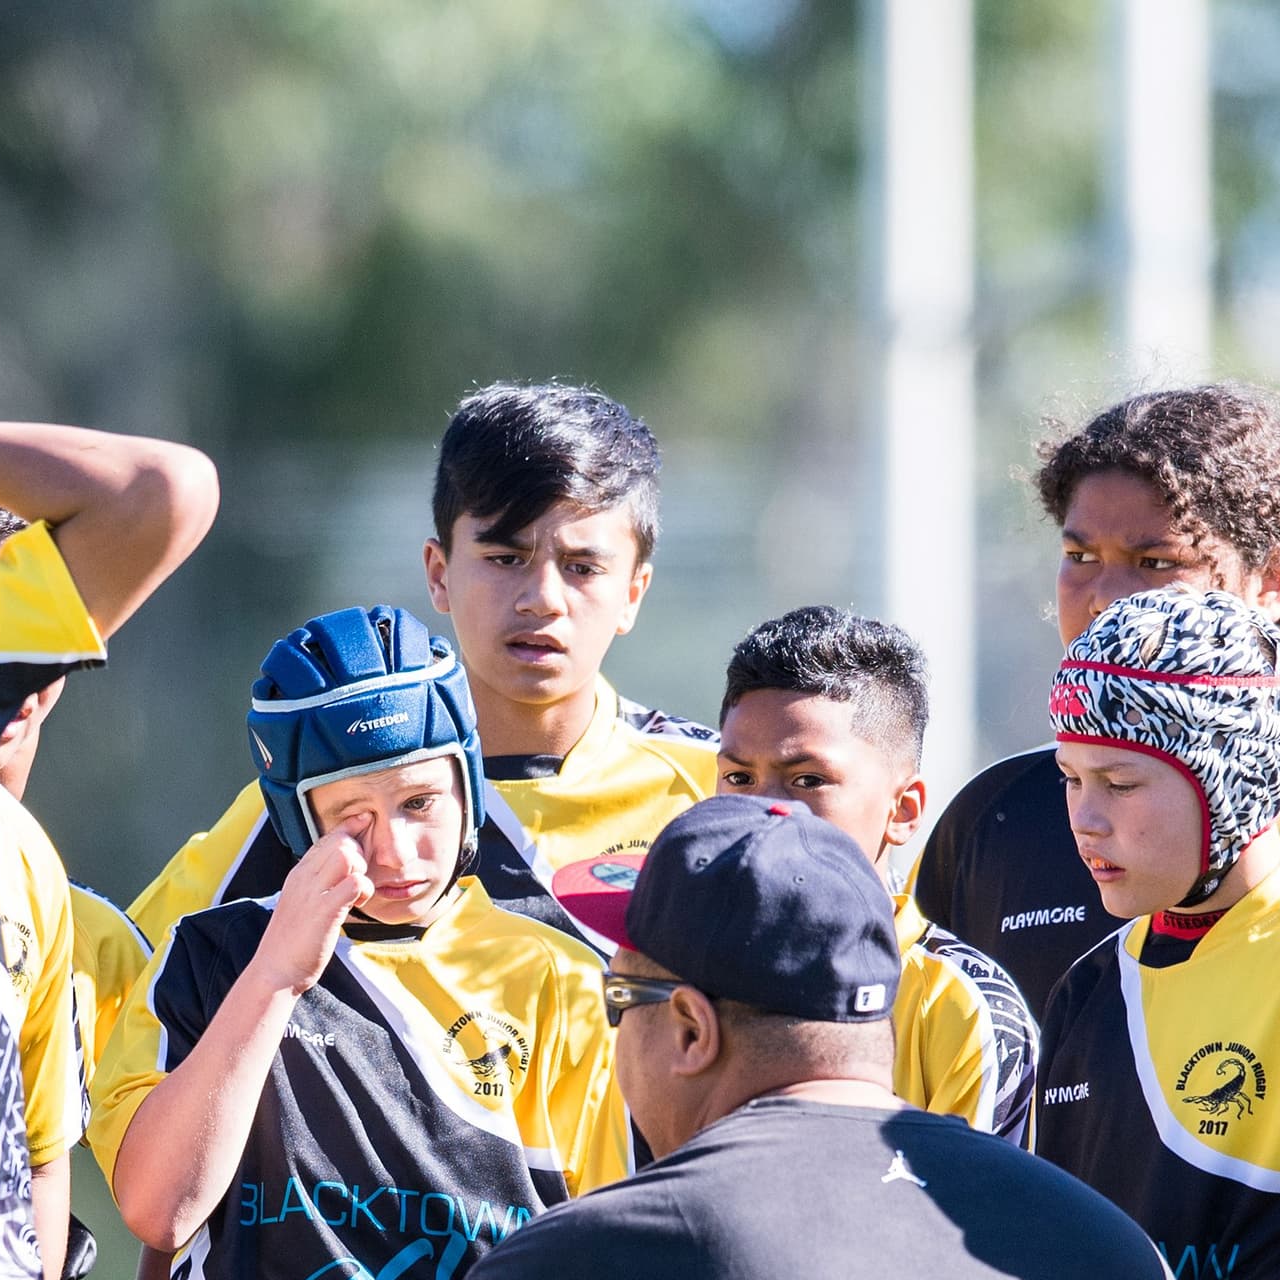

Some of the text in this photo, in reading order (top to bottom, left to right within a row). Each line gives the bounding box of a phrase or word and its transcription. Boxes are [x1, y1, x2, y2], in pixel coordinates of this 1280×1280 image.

[360, 712, 409, 732] STEEDEN
[1001, 905, 1085, 933] PLAYMORE
[283, 1020, 336, 1047] MORE
[1176, 1042, 1266, 1100] BLACKTOWN JUNIOR RUGBY
[474, 1082, 504, 1097] 2017
[1198, 1119, 1228, 1136] 2017
